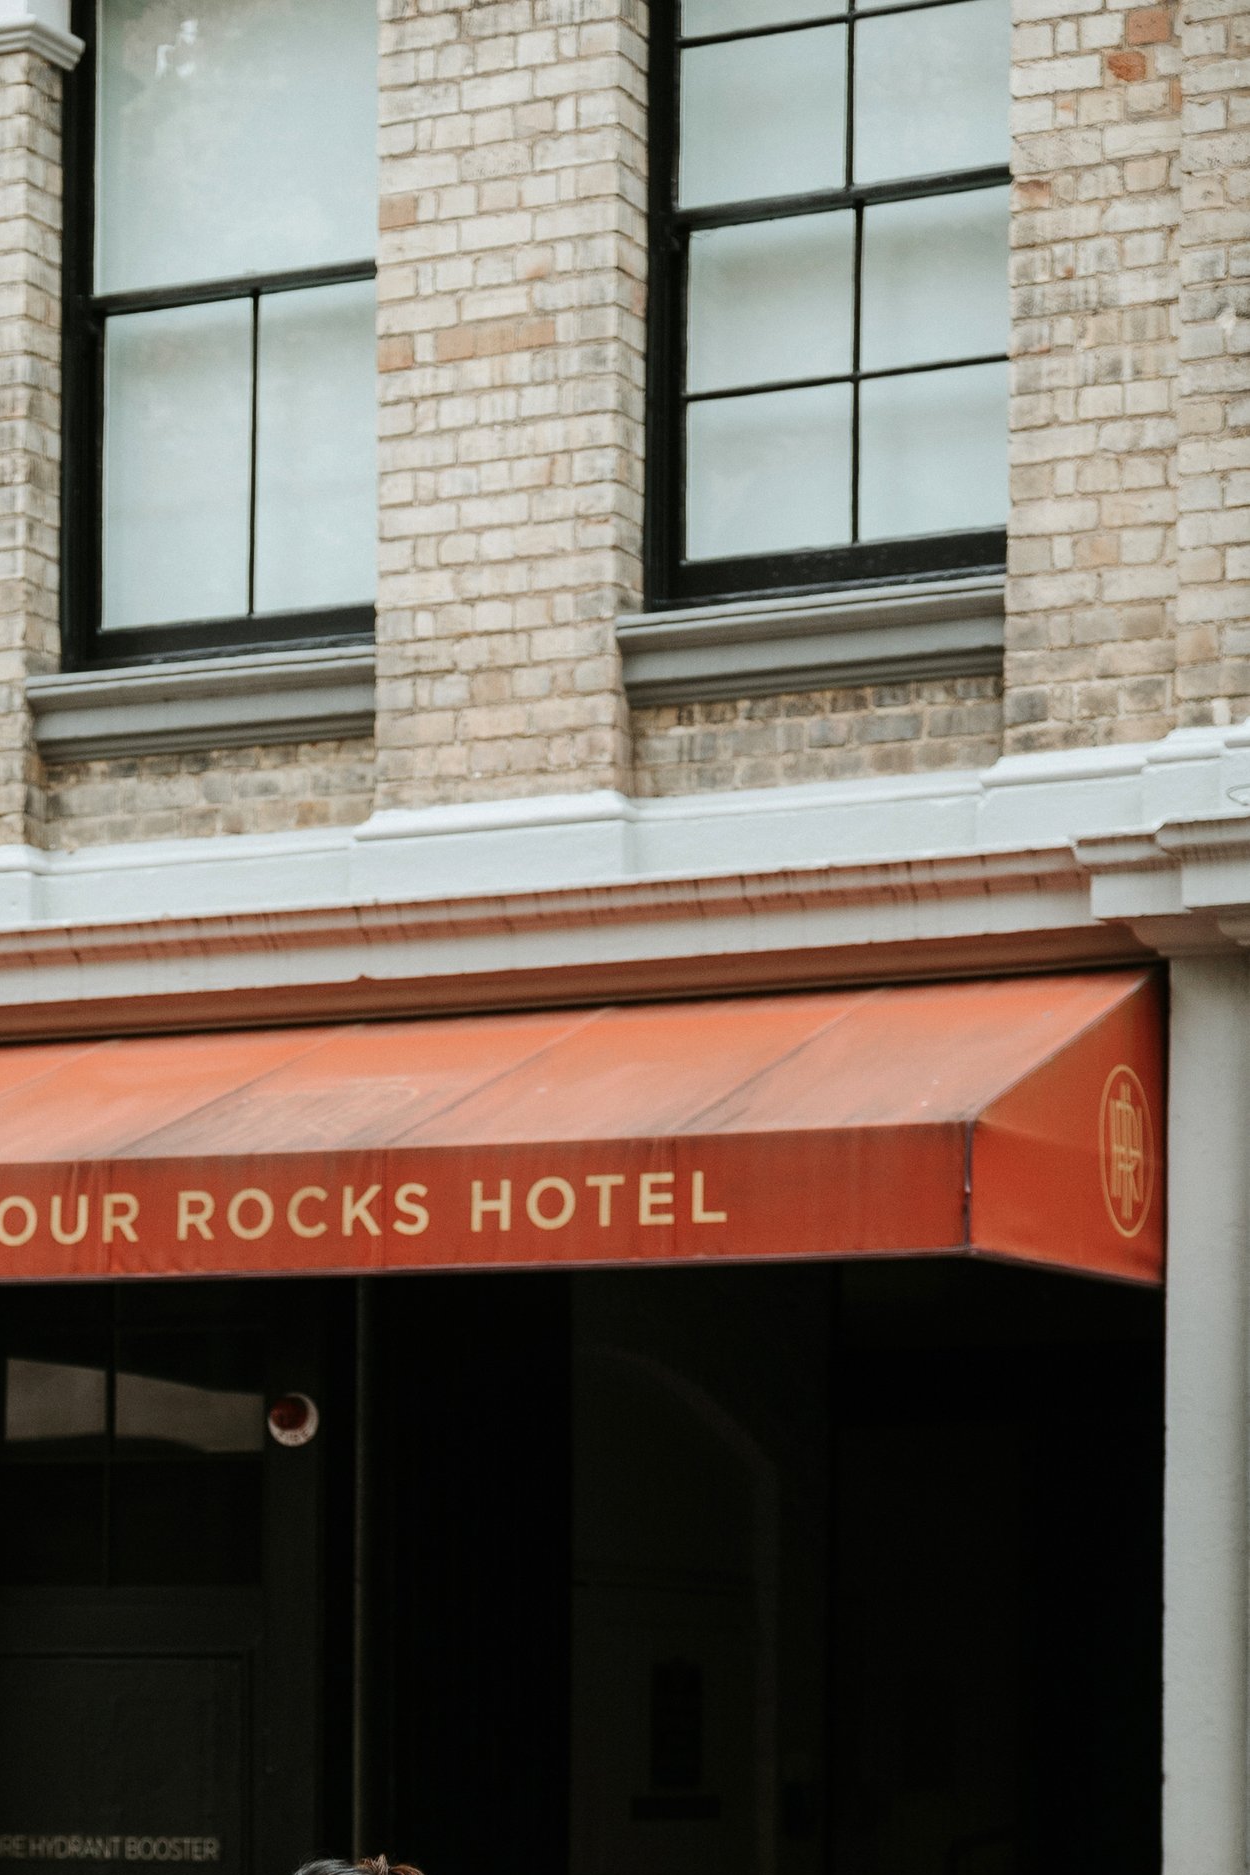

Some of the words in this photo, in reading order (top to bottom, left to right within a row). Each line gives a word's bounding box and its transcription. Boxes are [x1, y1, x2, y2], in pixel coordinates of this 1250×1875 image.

[177, 1182, 430, 1241] ROCKS
[470, 1170, 728, 1233] HOTEL
[29, 1835, 120, 1860] HYDRANT
[124, 1836, 220, 1861] BOOSTER
